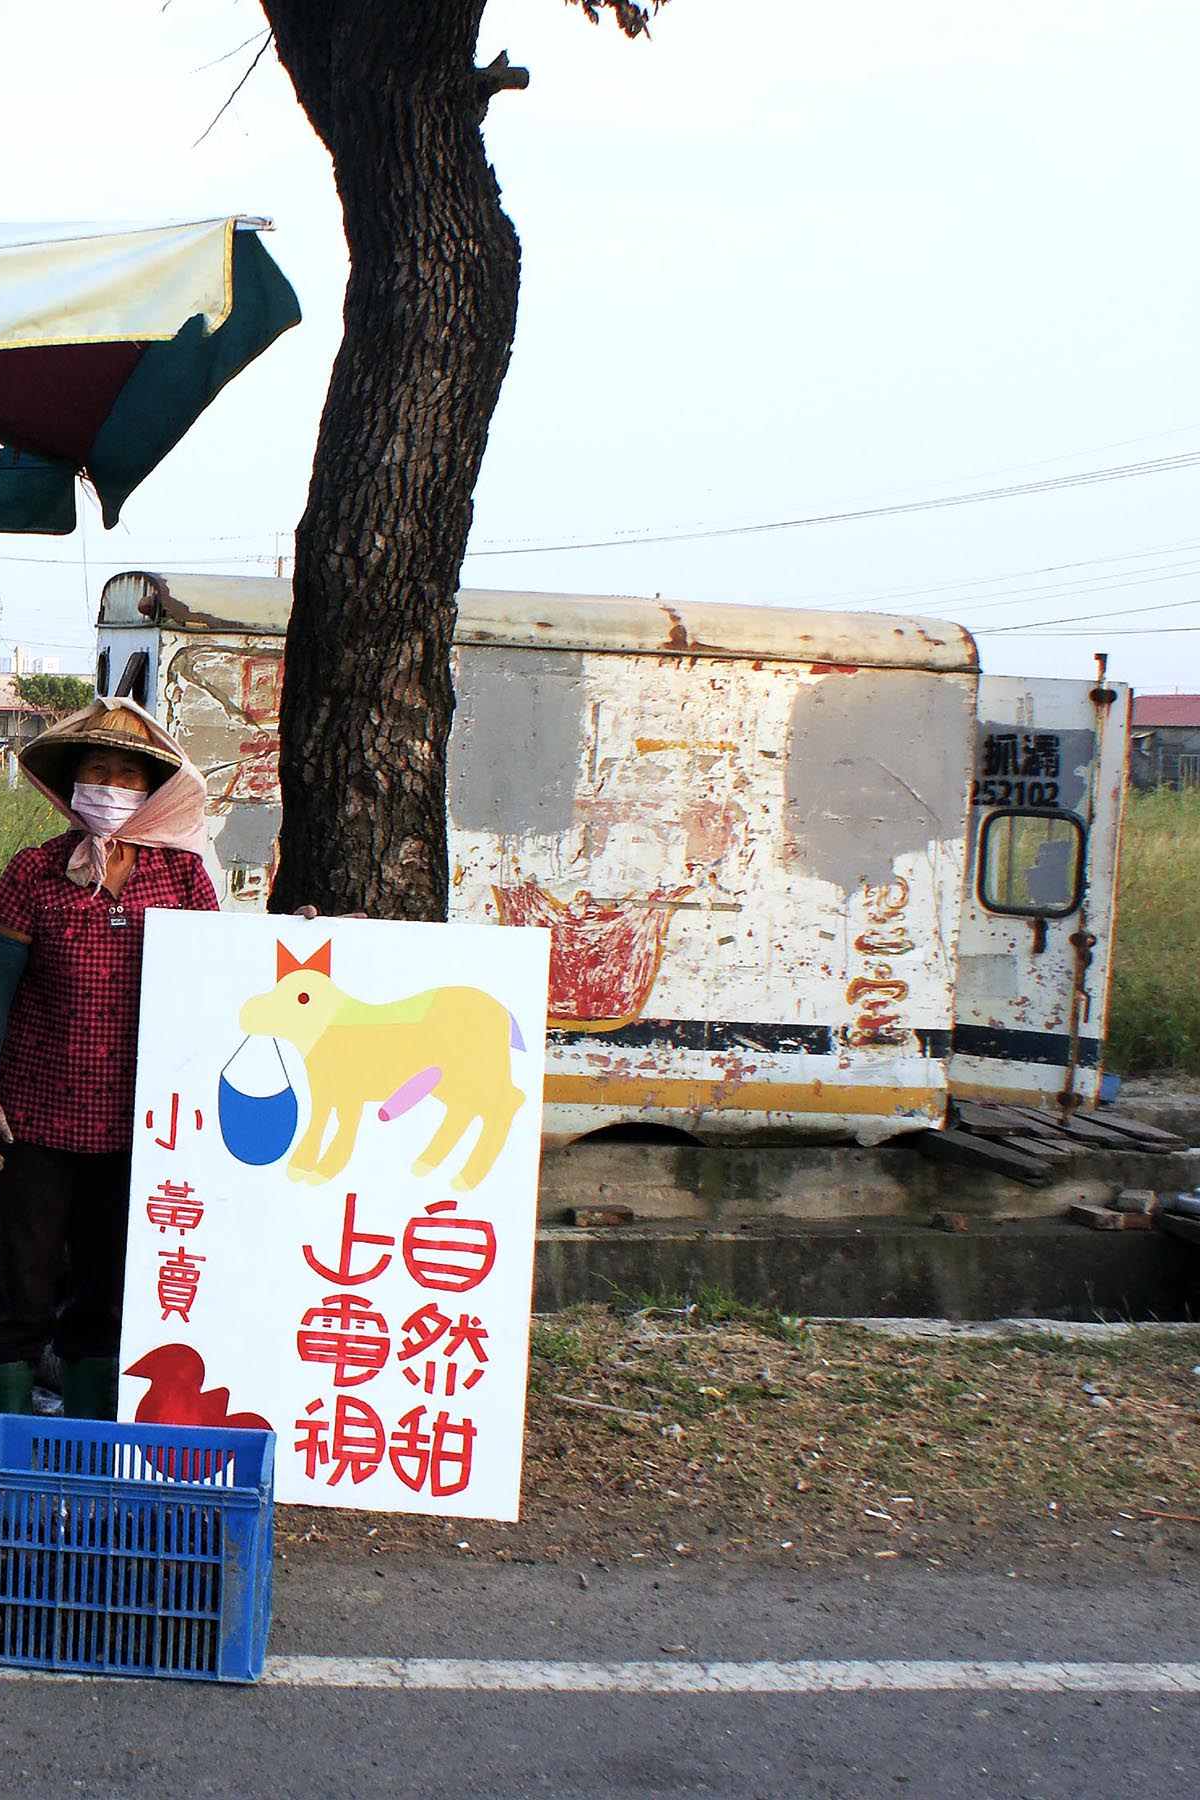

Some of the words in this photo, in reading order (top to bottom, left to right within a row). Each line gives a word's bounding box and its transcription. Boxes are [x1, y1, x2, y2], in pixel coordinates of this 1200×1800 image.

[295, 1193, 395, 1485] 上電視
[390, 1200, 497, 1497] 自然甜
